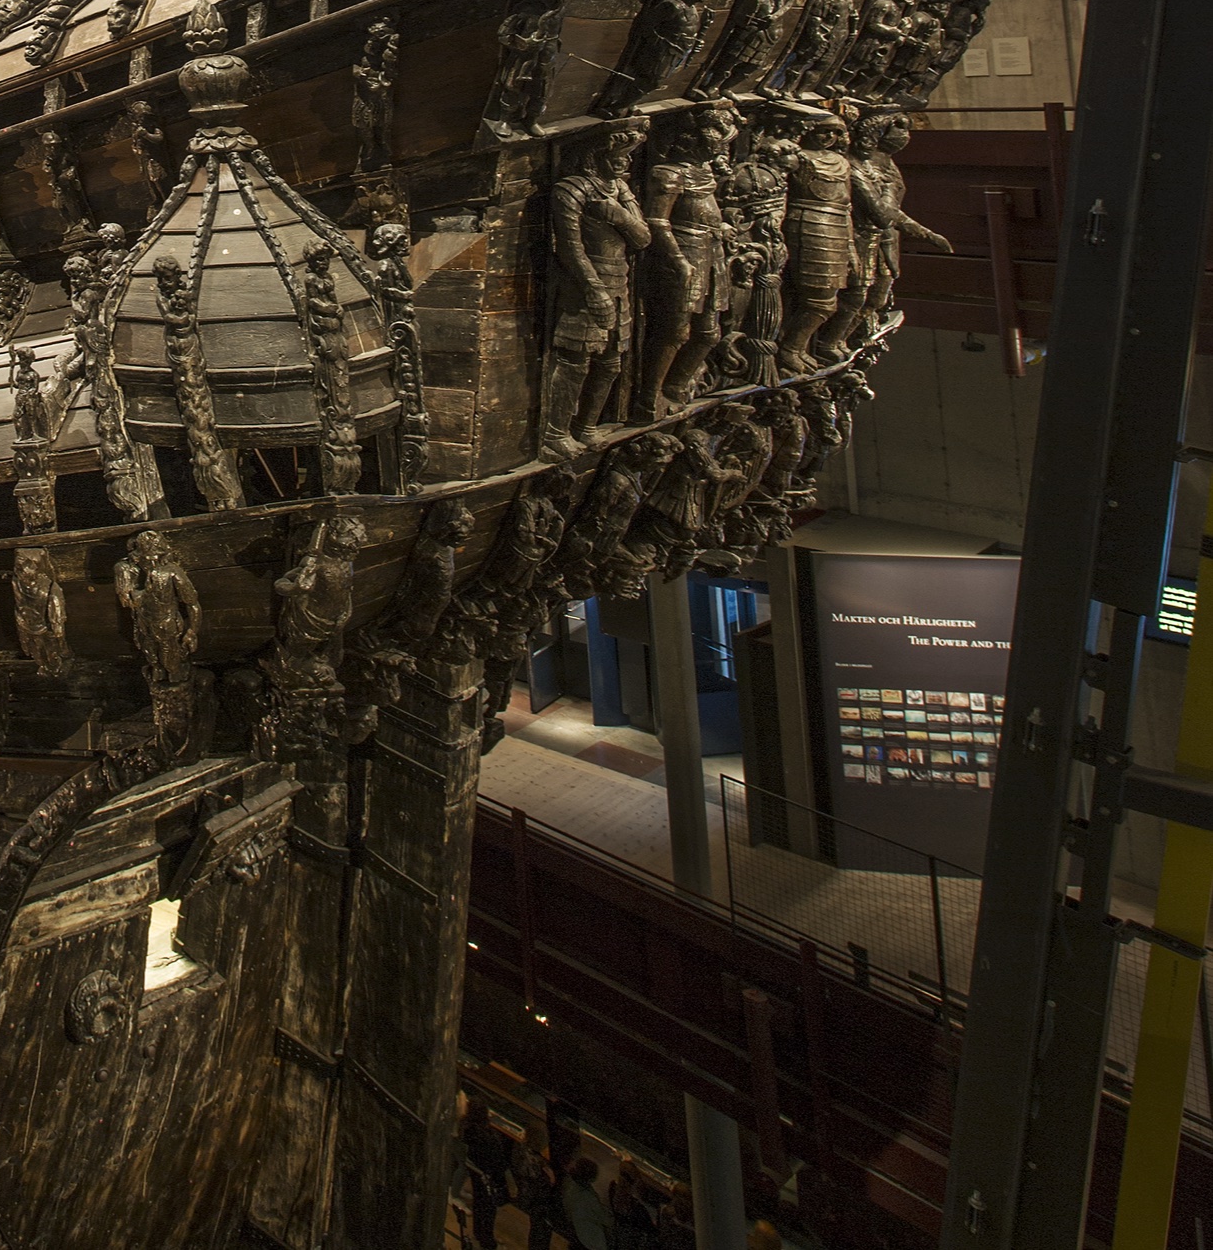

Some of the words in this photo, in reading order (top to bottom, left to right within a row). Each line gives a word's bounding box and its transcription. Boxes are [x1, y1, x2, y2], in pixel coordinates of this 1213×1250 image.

[832, 613, 876, 624] MAKTEN
[878, 616, 900, 625] OCH
[903, 616, 976, 628] HÄRLIGHETEN
[908, 635, 930, 646] THE
[932, 637, 969, 648] POWER
[970, 640, 993, 649] AND
[995, 641, 1011, 650] TH
